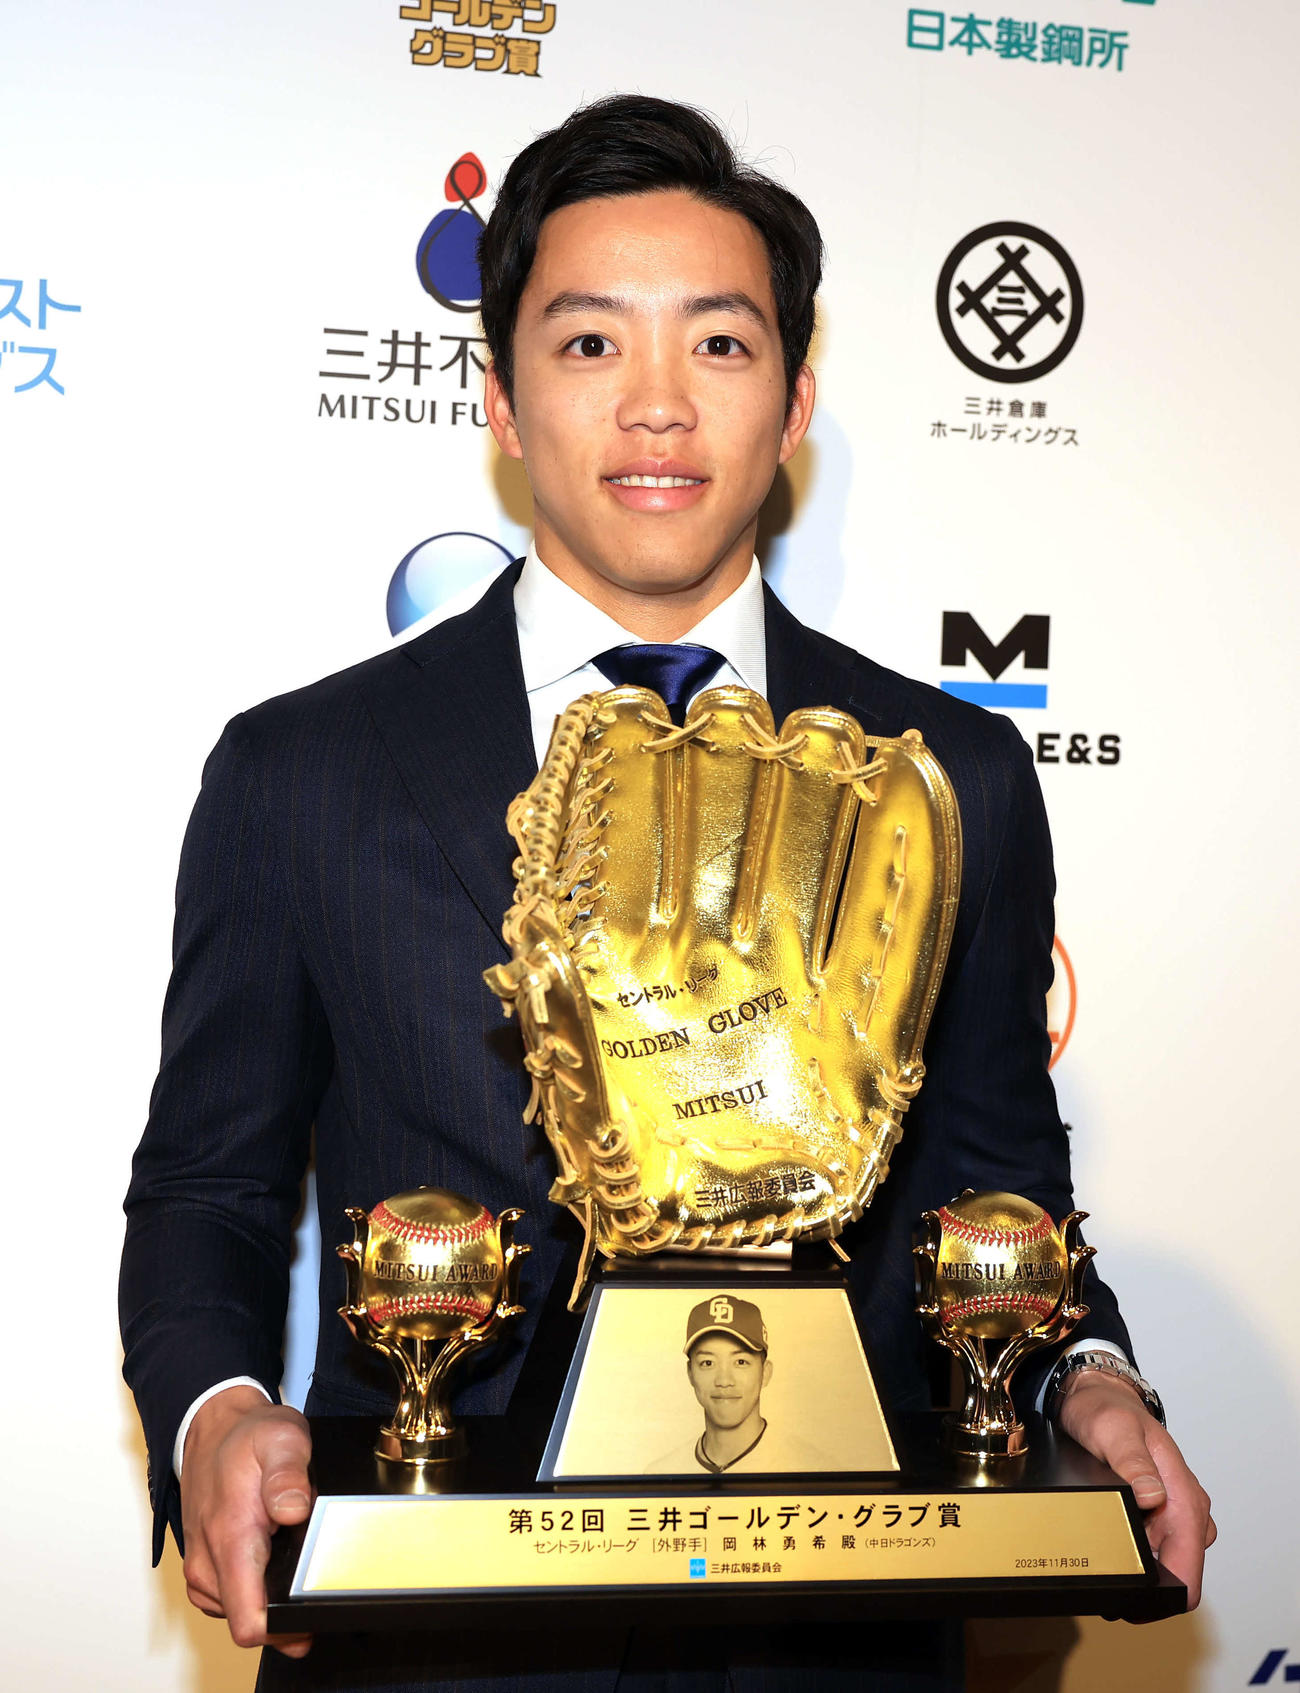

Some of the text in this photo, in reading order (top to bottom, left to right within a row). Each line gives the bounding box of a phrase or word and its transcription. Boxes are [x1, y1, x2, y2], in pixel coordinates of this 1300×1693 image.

[410, 26, 542, 78] グラブ賞
[907, 8, 1129, 72] 日本製鋼所
[319, 327, 488, 389] 三井不
[318, 393, 437, 424] MITSUI
[963, 396, 1048, 419] 三井倉庫
[930, 420, 1079, 446] ホールディングス
[1037, 732, 1121, 765] E&S
[616, 966, 720, 1009] セントラル・リーグ
[601, 987, 788, 1060] GOLDEN GLOVE
[672, 1079, 769, 1120] MITSUI
[694, 1171, 817, 1209] 三井広報委員会
[374, 1260, 499, 1284] MITSUI AWARD
[941, 1261, 1062, 1282] MITSUI AWARD
[508, 1502, 961, 1534] 第52回 三井ゴールデン・グラブ賞
[533, 1537, 640, 1554] セントラル・リーグ
[710, 1562, 782, 1574] 三井広報委員会
[1015, 1557, 1089, 1569] 2023年11月30日
